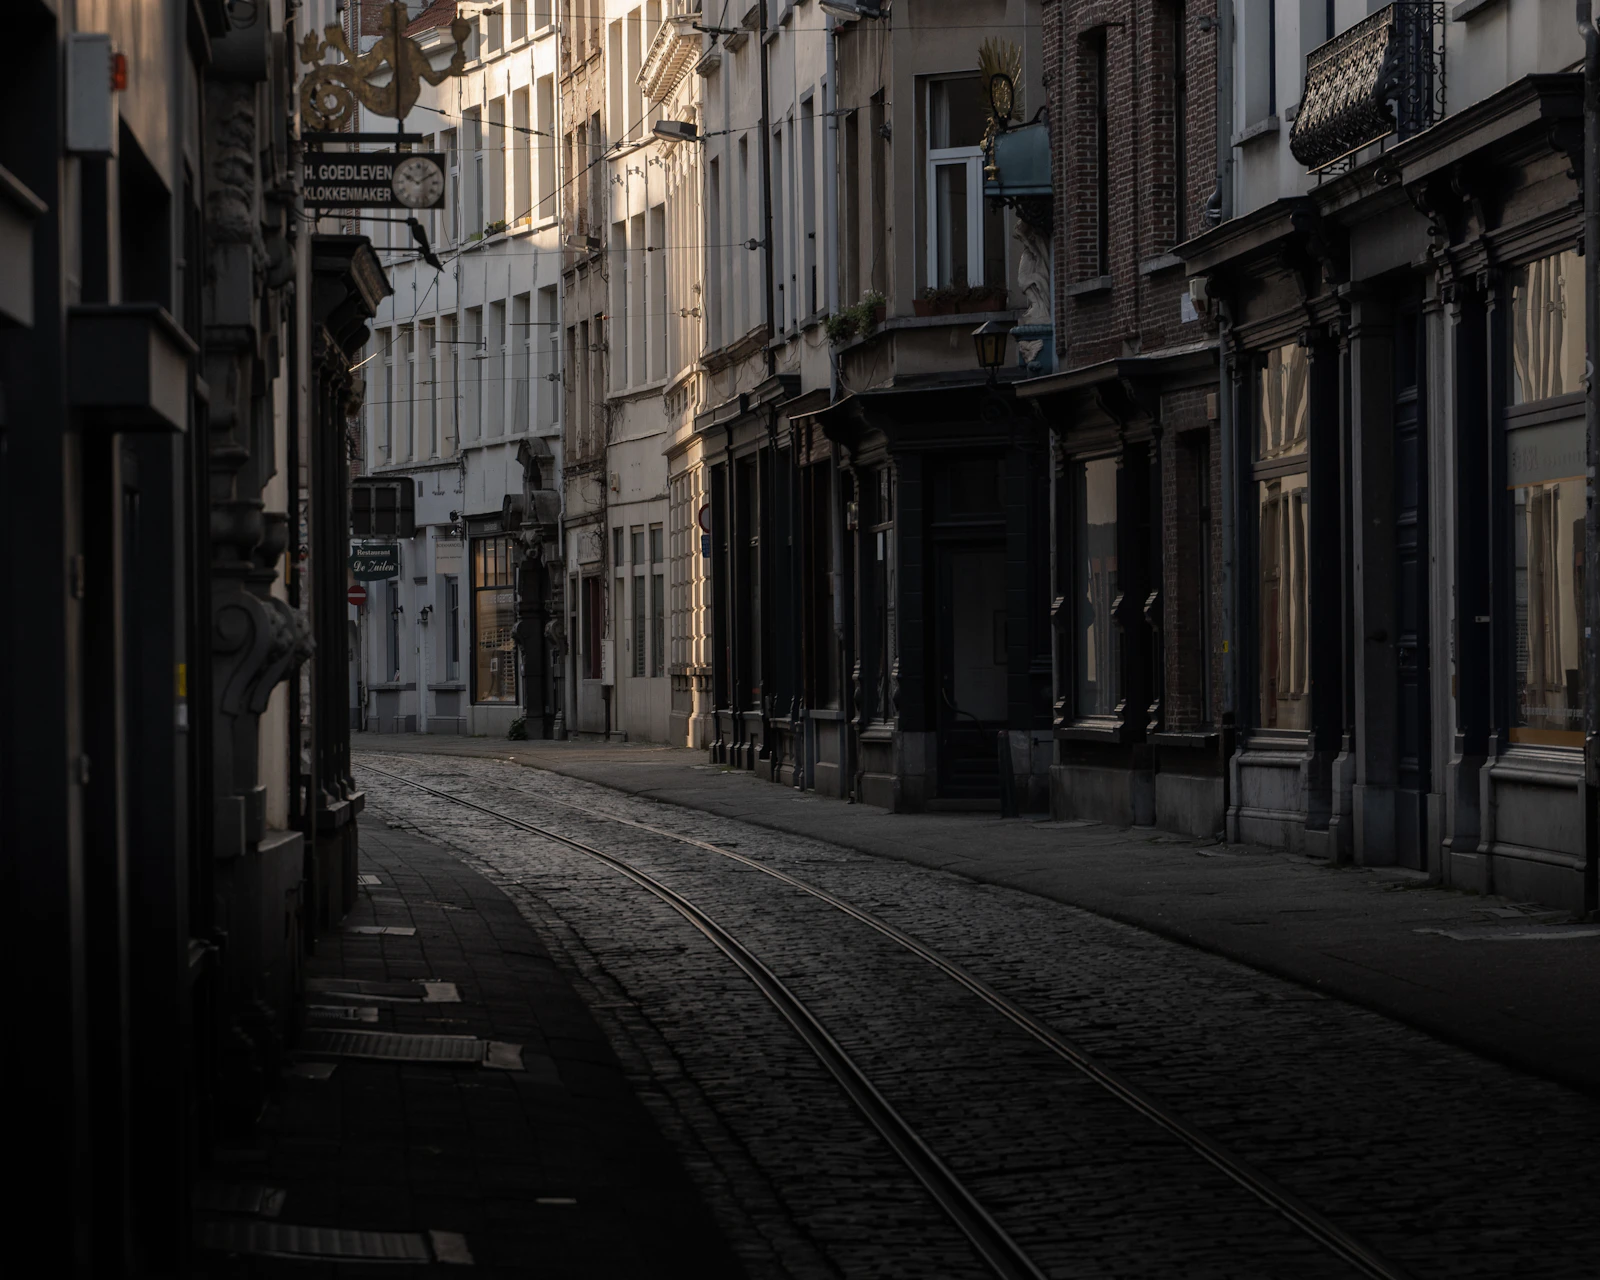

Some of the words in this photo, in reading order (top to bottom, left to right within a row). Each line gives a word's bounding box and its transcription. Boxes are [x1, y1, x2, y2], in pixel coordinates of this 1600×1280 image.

[304, 165, 316, 180] H.
[319, 165, 392, 180] GOEDLEVEN
[303, 186, 391, 201] KLOKKENMAKER
[353, 560, 366, 572] De
[367, 560, 394, 572] Zuilen
